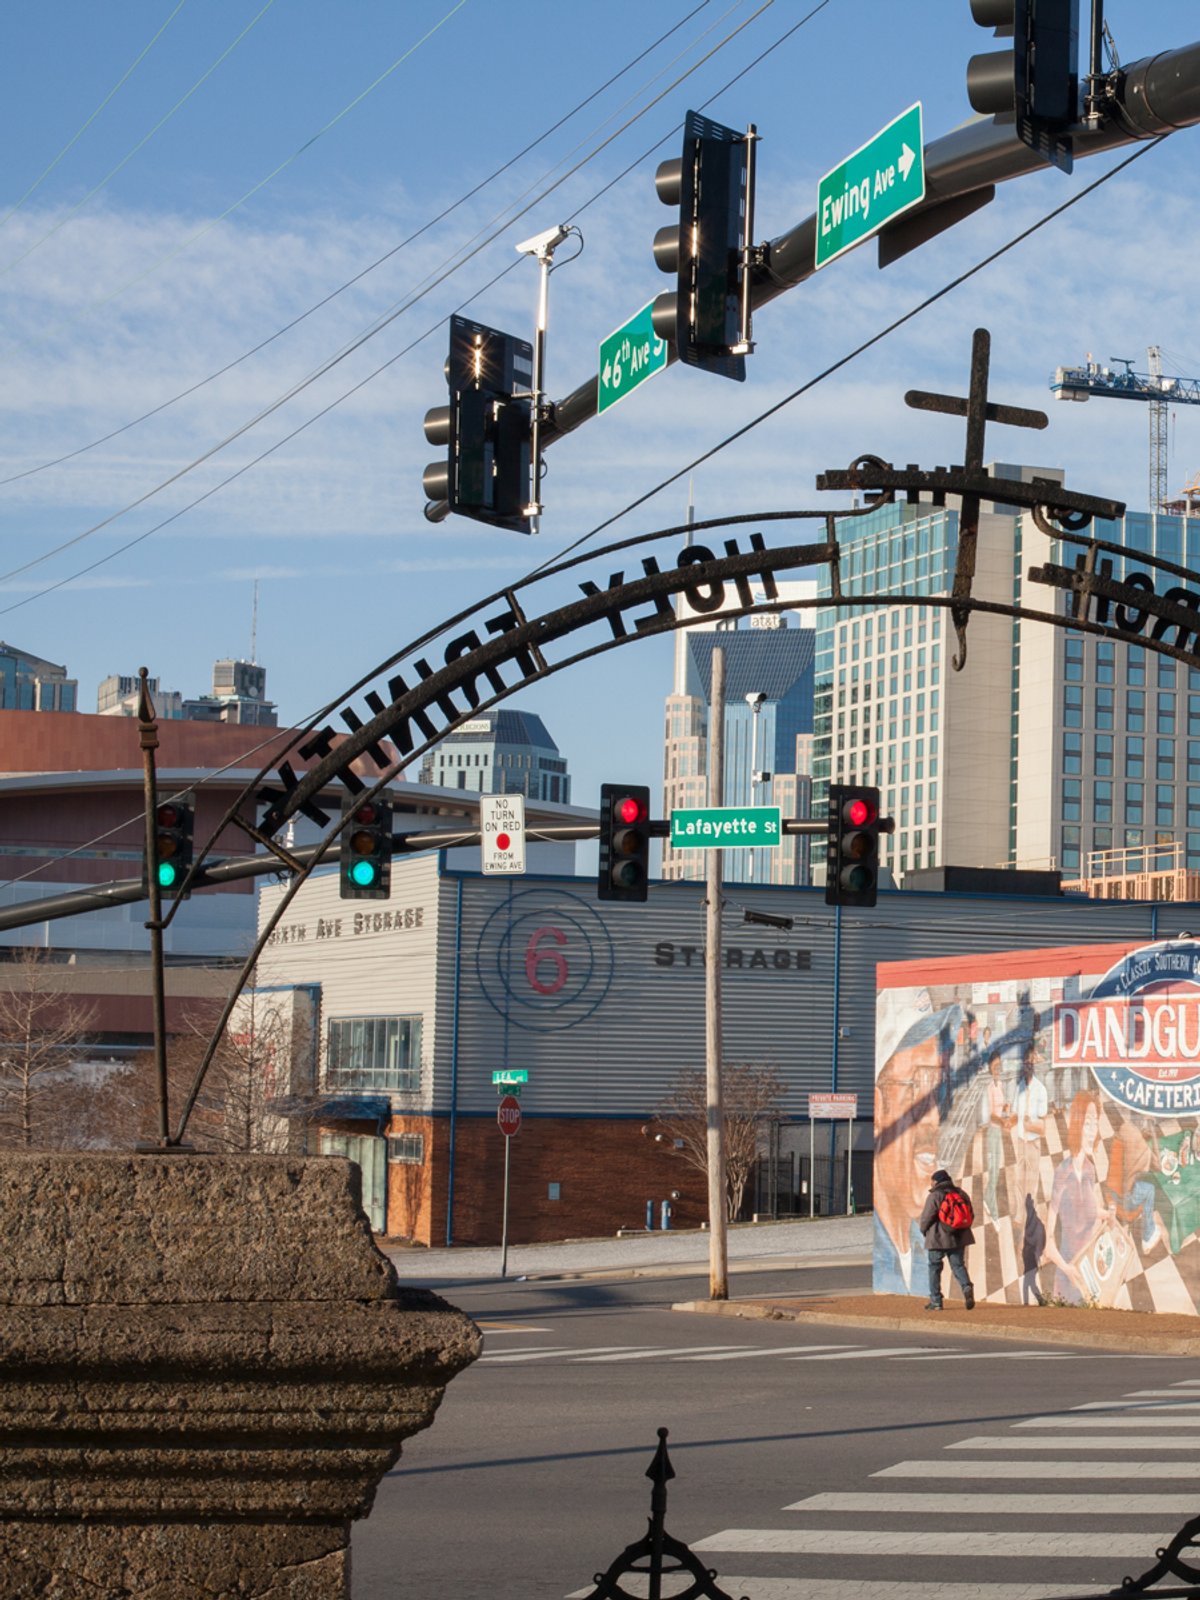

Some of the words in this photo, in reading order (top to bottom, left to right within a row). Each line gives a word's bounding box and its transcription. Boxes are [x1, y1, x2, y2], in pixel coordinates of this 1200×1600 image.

[822, 177, 870, 237] Ewing
[874, 165, 895, 199] Ave
[612, 337, 630, 389] 6th
[630, 341, 650, 376] Ave
[751, 614, 779, 628] at&t
[495, 799, 509, 810] NO
[490, 810, 515, 821] TURN
[485, 821, 499, 832] ON
[503, 821, 521, 832] RED
[674, 818, 757, 838] Lafayette
[764, 821, 777, 834] St
[493, 851, 515, 861] FROM
[485, 862, 505, 871] EWING
[508, 861, 523, 870] AVE
[268, 924, 307, 945] SIXTH
[316, 918, 343, 940] AVE
[353, 906, 424, 935] STORAGE
[525, 926, 569, 995] 6
[655, 942, 812, 970] STRAGE
[1120, 957, 1151, 988] CLASSIC
[1155, 953, 1191, 972] SOUTHERN
[500, 1108, 520, 1123] STOP
